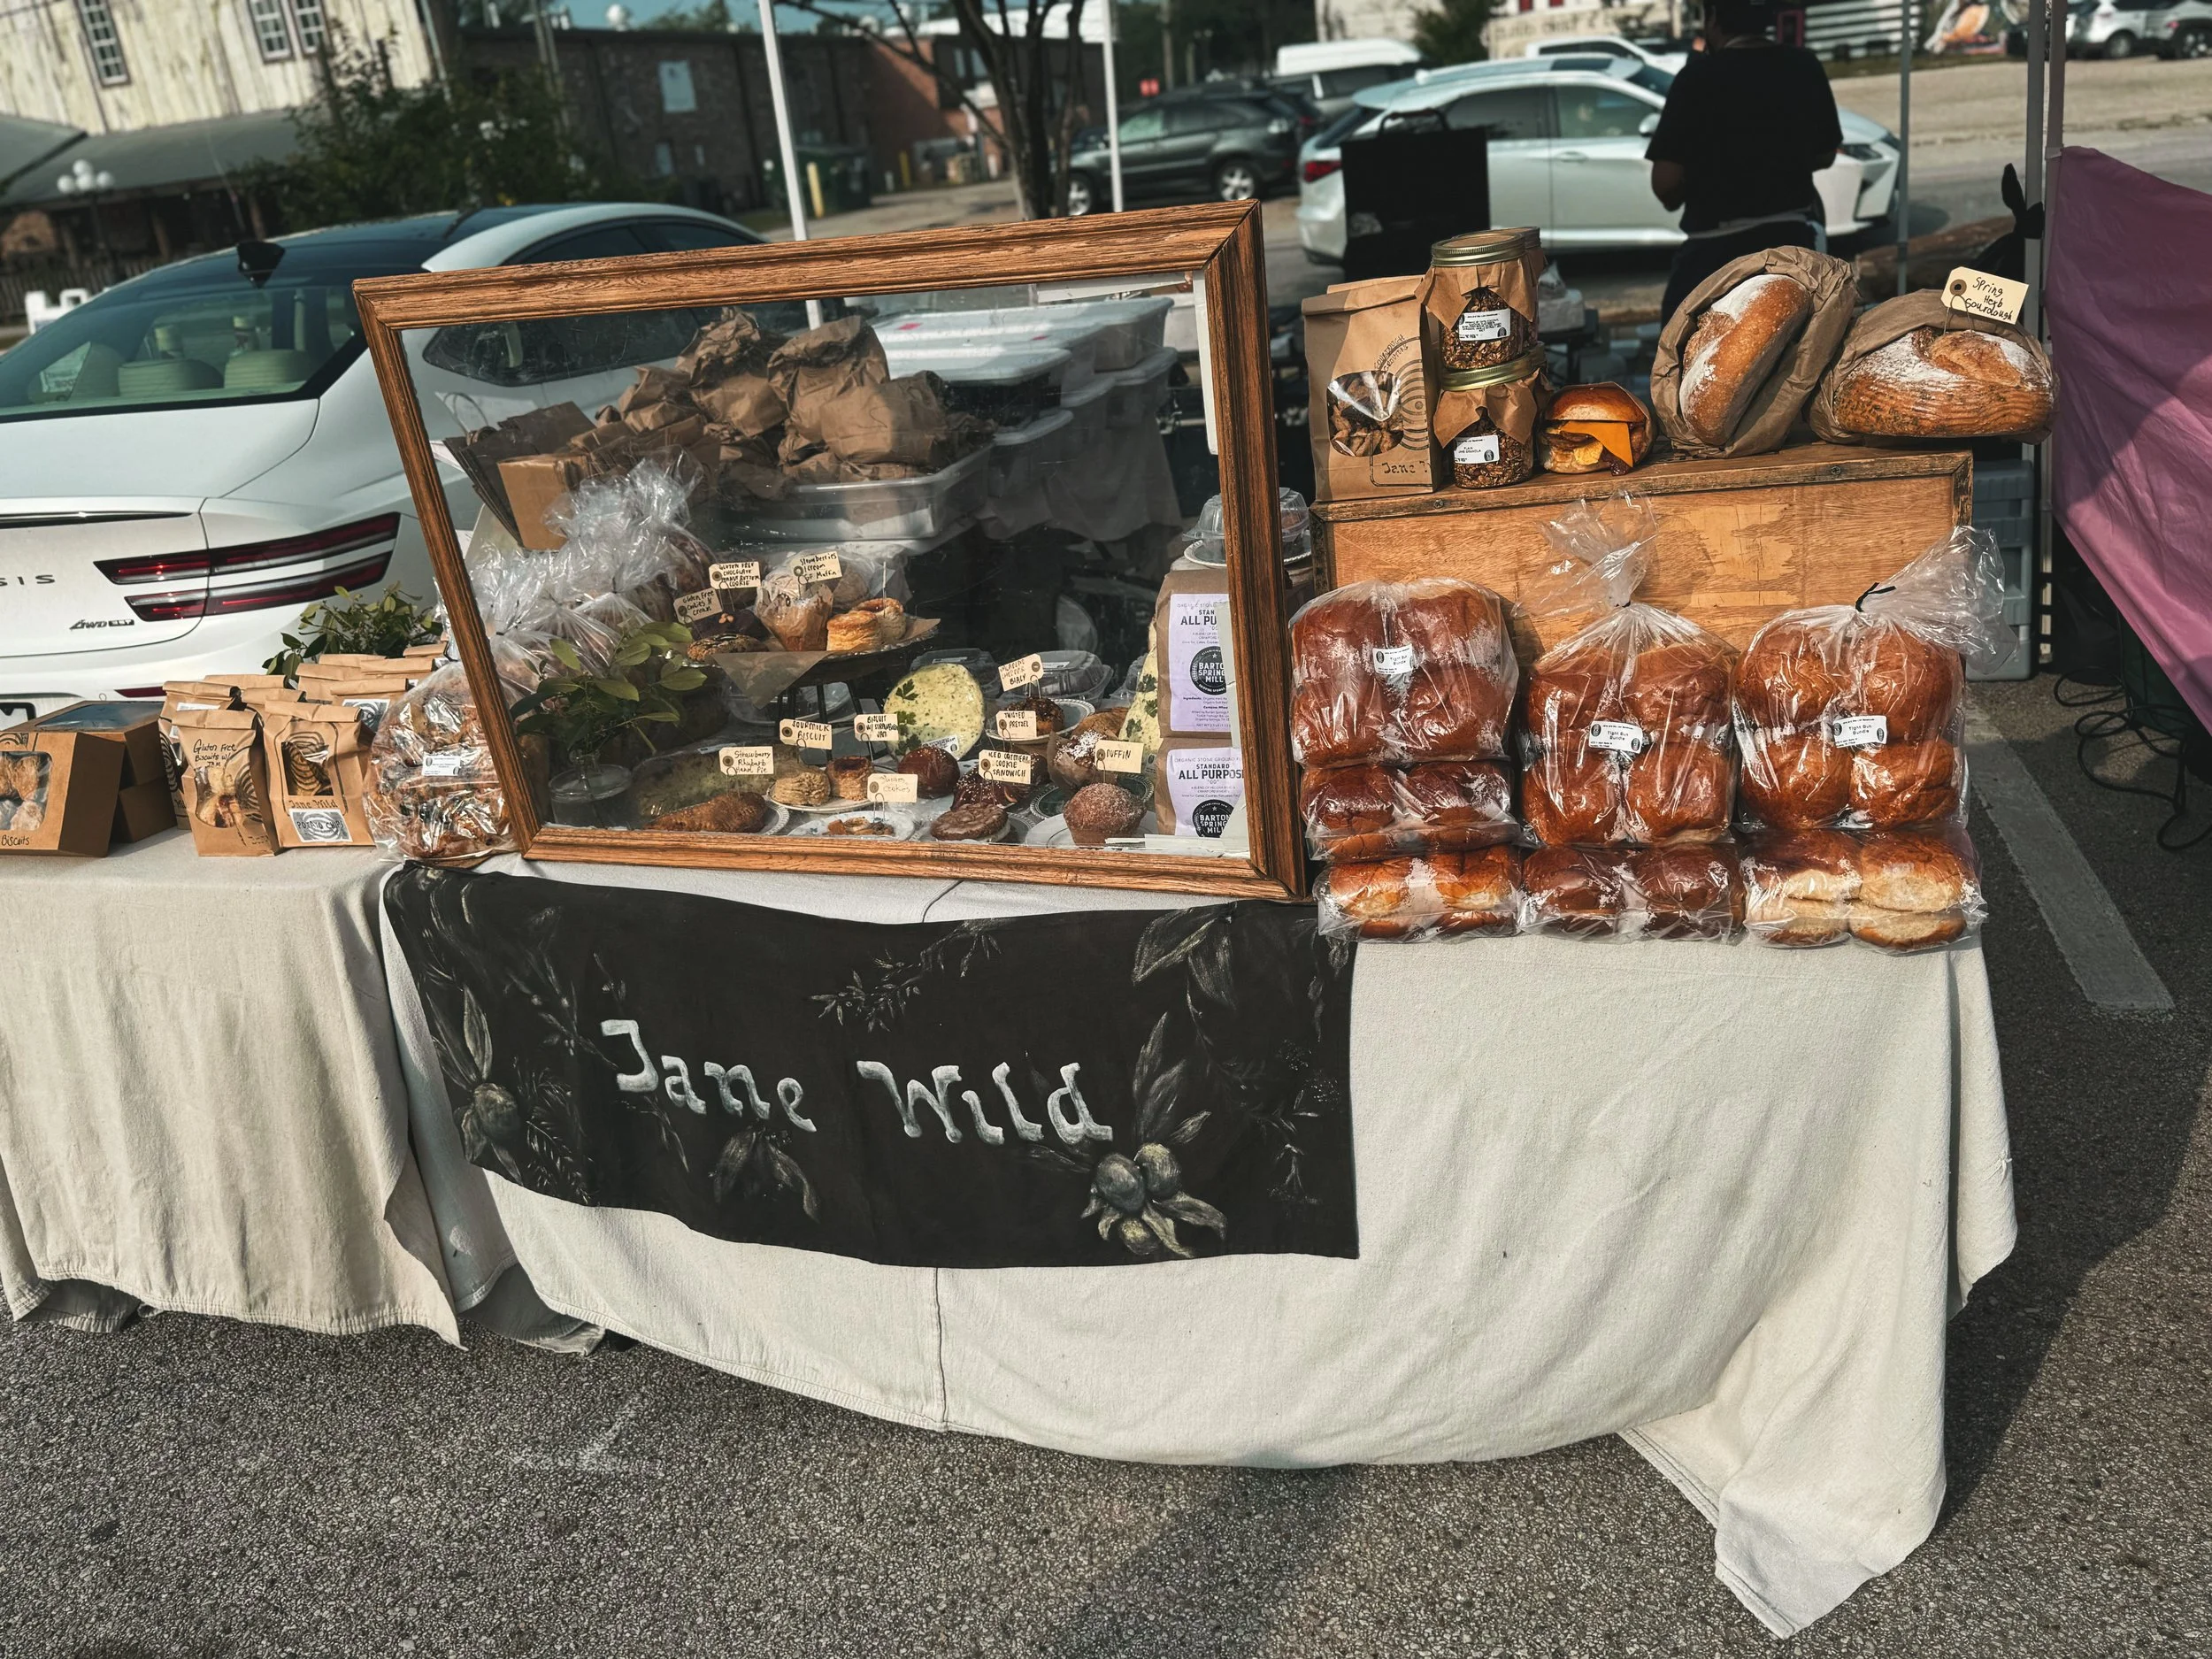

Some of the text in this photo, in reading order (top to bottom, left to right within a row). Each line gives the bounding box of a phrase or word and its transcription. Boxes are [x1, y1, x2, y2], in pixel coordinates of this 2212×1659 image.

[1972, 276, 2004, 297] Spring
[1984, 295, 2003, 308] Herb
[1964, 297, 2014, 321] Sourdough
[1381, 462, 1416, 474] Jane
[1180, 615, 1201, 626] ALL
[1010, 672, 1026, 685] BIALY
[792, 720, 830, 732] SOURMILK
[797, 730, 828, 741] BISCUIT
[220, 743, 237, 752] Free
[195, 752, 219, 762] Biscuits
[733, 749, 771, 759] Strawberry
[1106, 749, 1132, 761] DUFFIN
[995, 759, 1018, 769] COOKIE
[992, 768, 1026, 778] SANDWICH
[1178, 769, 1199, 780] ALL
[288, 799, 338, 809] Jane Wild
[296, 819, 344, 830] POTATO CHIPS
[601, 1018, 1113, 1145] Jane Wild
